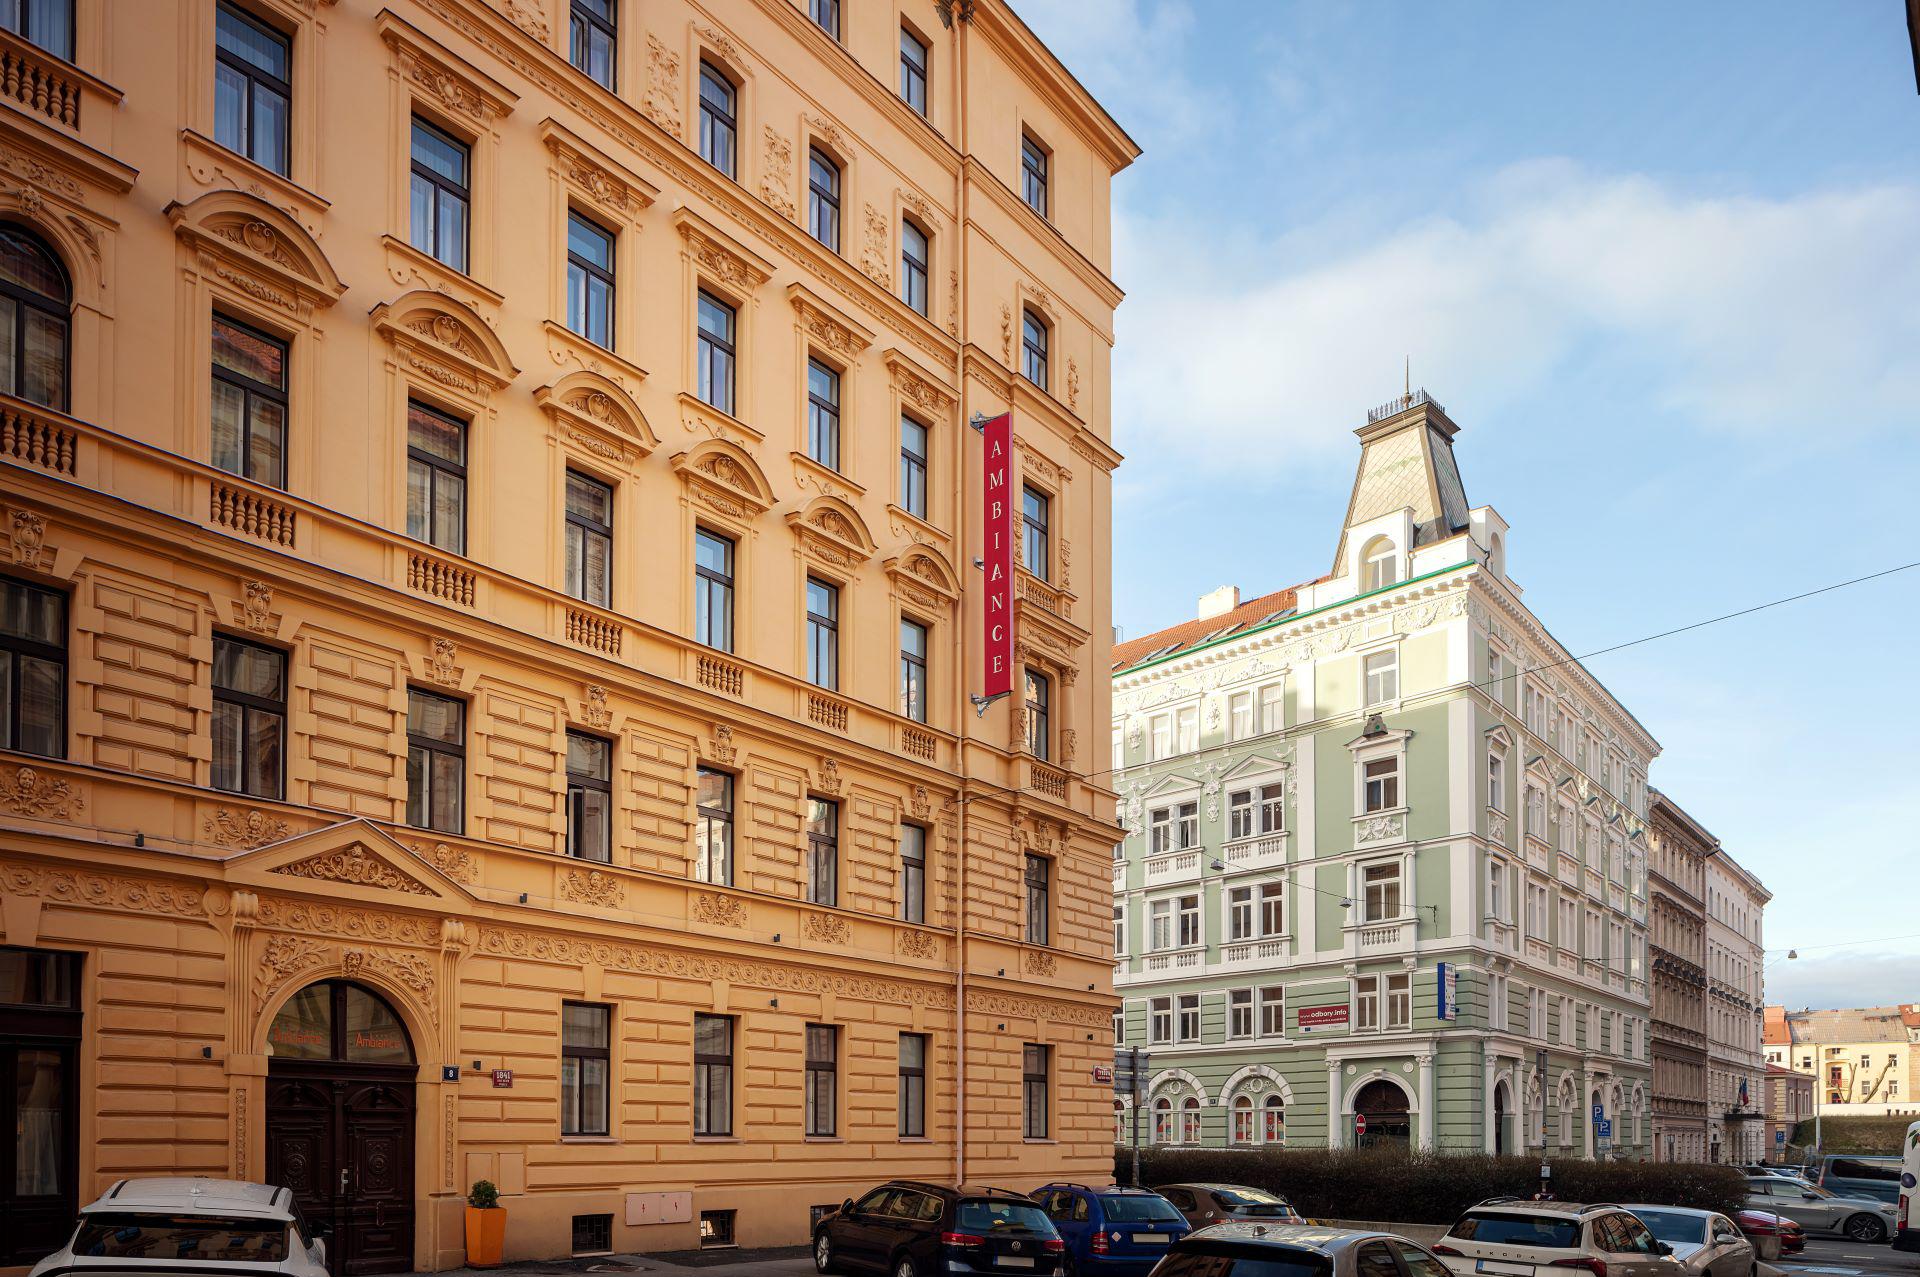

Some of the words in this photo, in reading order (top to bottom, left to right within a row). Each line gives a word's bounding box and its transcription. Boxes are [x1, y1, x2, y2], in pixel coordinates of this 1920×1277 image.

[989, 439, 1004, 674] AMBIANCE
[449, 1070, 454, 1078] 8
[496, 1071, 510, 1079] 1841
[1595, 1107, 1602, 1118] P
[1600, 1122, 1608, 1132] P
